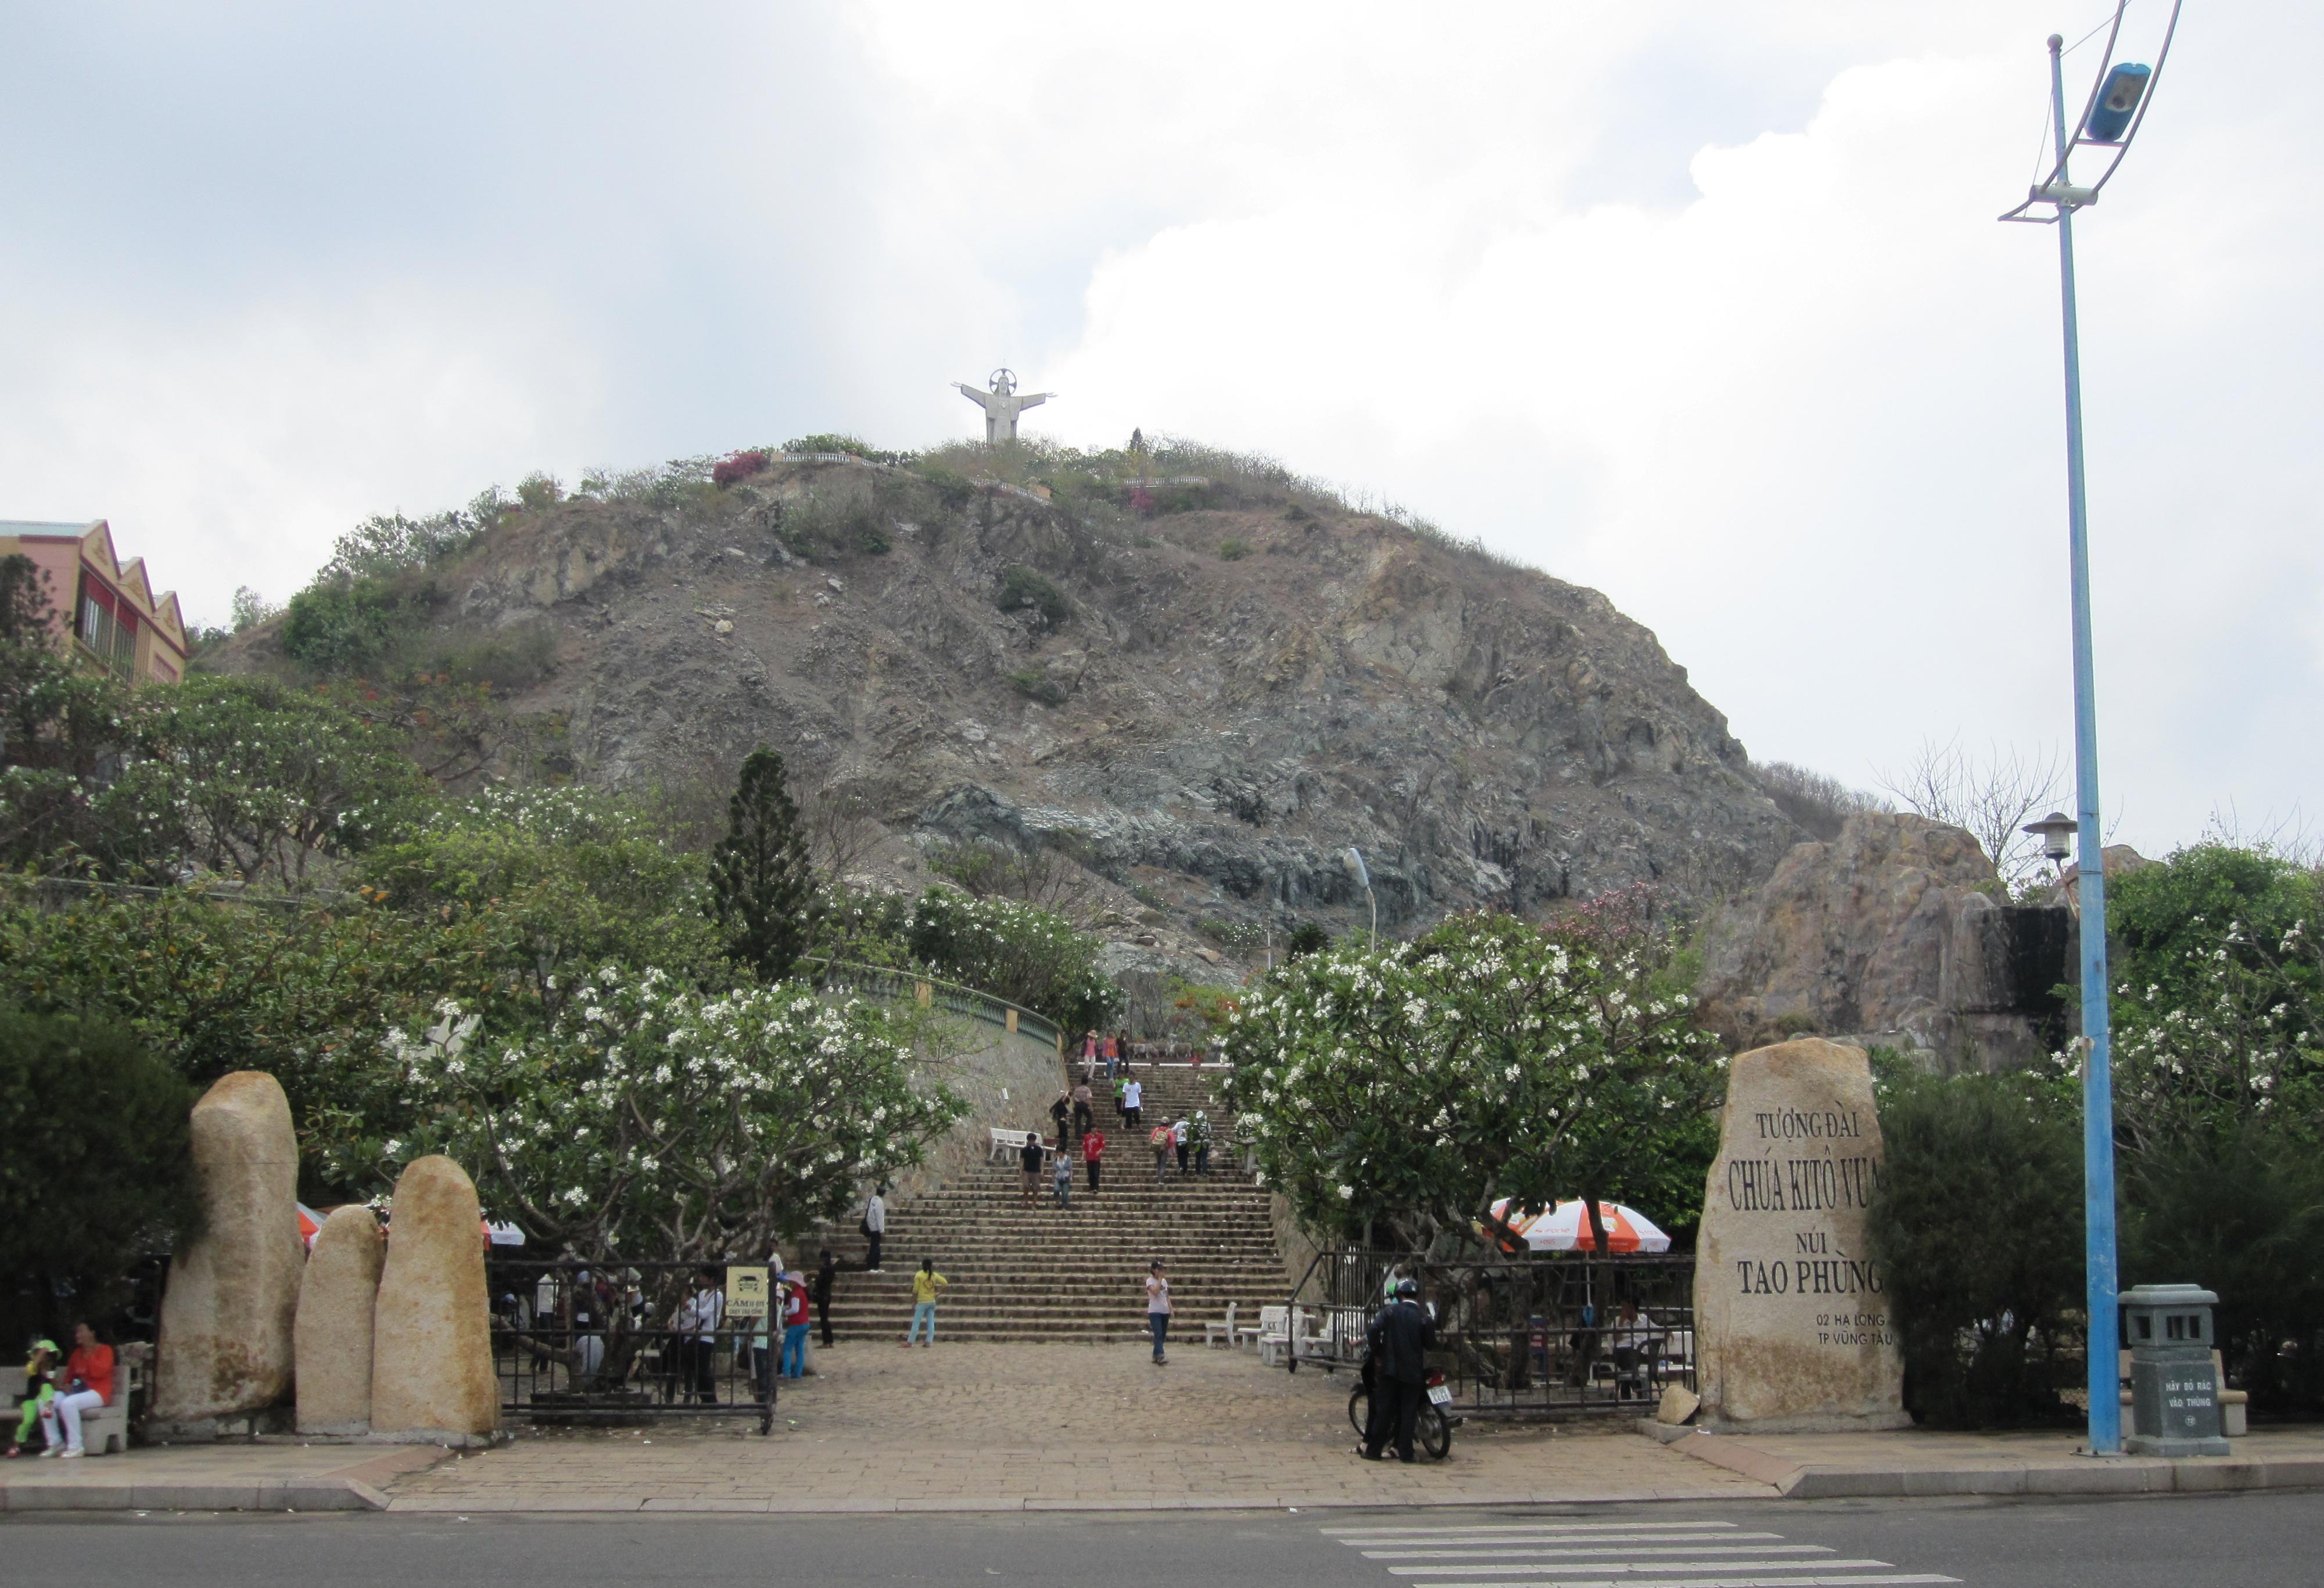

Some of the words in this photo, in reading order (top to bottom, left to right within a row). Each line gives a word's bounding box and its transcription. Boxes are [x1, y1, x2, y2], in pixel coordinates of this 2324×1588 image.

[1756, 1107, 1821, 1143] TƯỢNG
[1825, 1100, 1860, 1137] ĐÀI
[1728, 1147, 1786, 1210] CHÚA
[1788, 1144, 1836, 1210] KITÔ
[1796, 1226, 1827, 1253] NÚI
[1737, 1260, 1788, 1294] TAO
[1796, 1250, 1884, 1293] PHÙNG
[1816, 1314, 1829, 1326] 02
[1835, 1314, 1850, 1328] HẠ
[1855, 1314, 1885, 1326] LONG
[1818, 1333, 1829, 1345] TP
[1833, 1330, 1868, 1345] VŨNG
[1871, 1330, 1893, 1345] TÀU
[2197, 1379, 2211, 1390] RÁC
[2169, 1396, 2183, 1407] VÀO
[2186, 1396, 2211, 1406] THÙNG
